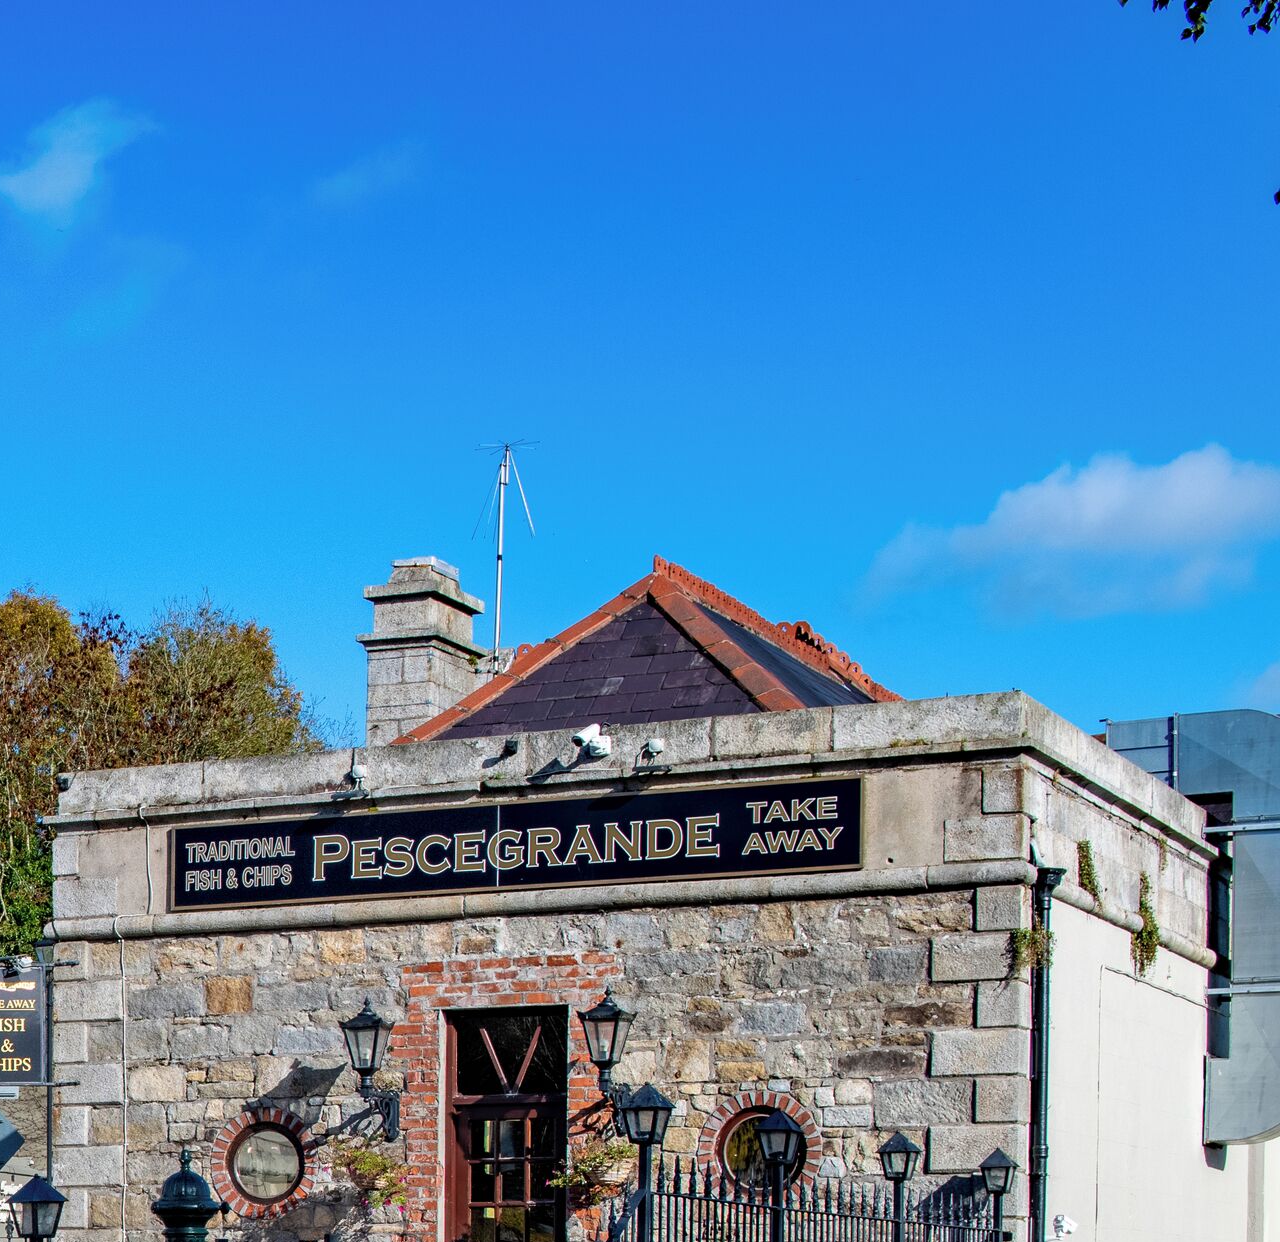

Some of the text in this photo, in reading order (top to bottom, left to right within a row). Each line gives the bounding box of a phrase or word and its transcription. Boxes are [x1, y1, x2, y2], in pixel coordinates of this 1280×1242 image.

[746, 796, 838, 824] TAKE
[185, 836, 296, 863] TRADITIONAL
[312, 813, 721, 882] PESCEGRANDE
[741, 826, 844, 855] AWAY
[185, 864, 292, 892] FISH & CHIPS
[6, 1000, 36, 1009] AWAY
[1, 1039, 14, 1053] &
